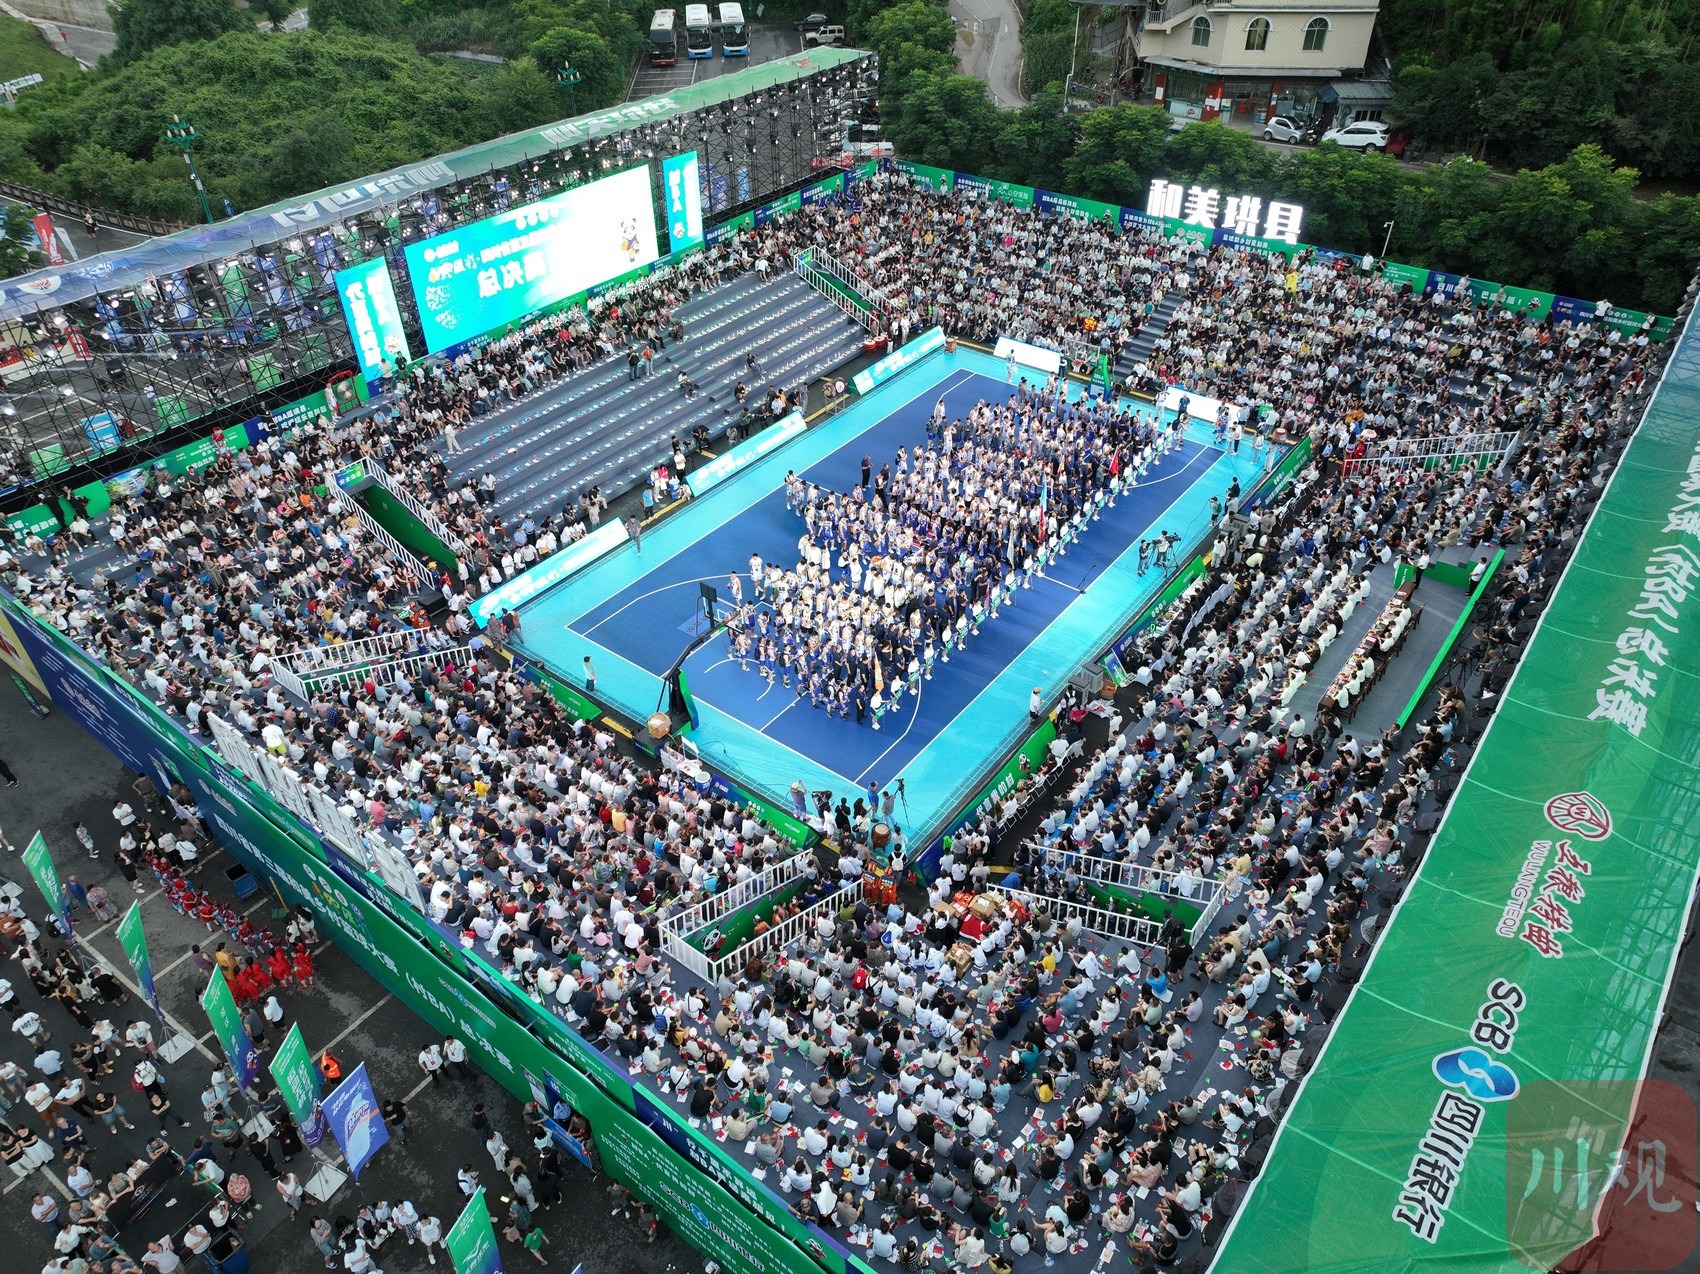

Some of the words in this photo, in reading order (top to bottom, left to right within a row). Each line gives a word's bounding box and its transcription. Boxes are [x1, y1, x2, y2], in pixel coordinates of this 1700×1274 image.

[1147, 179, 1303, 245] 和美珙县
[1496, 841, 1551, 938] WULIANGTEQU
[1520, 840, 1592, 958] 五粮特曲
[1471, 979, 1525, 1053] SCB
[1393, 1092, 1484, 1242] 四川银行
